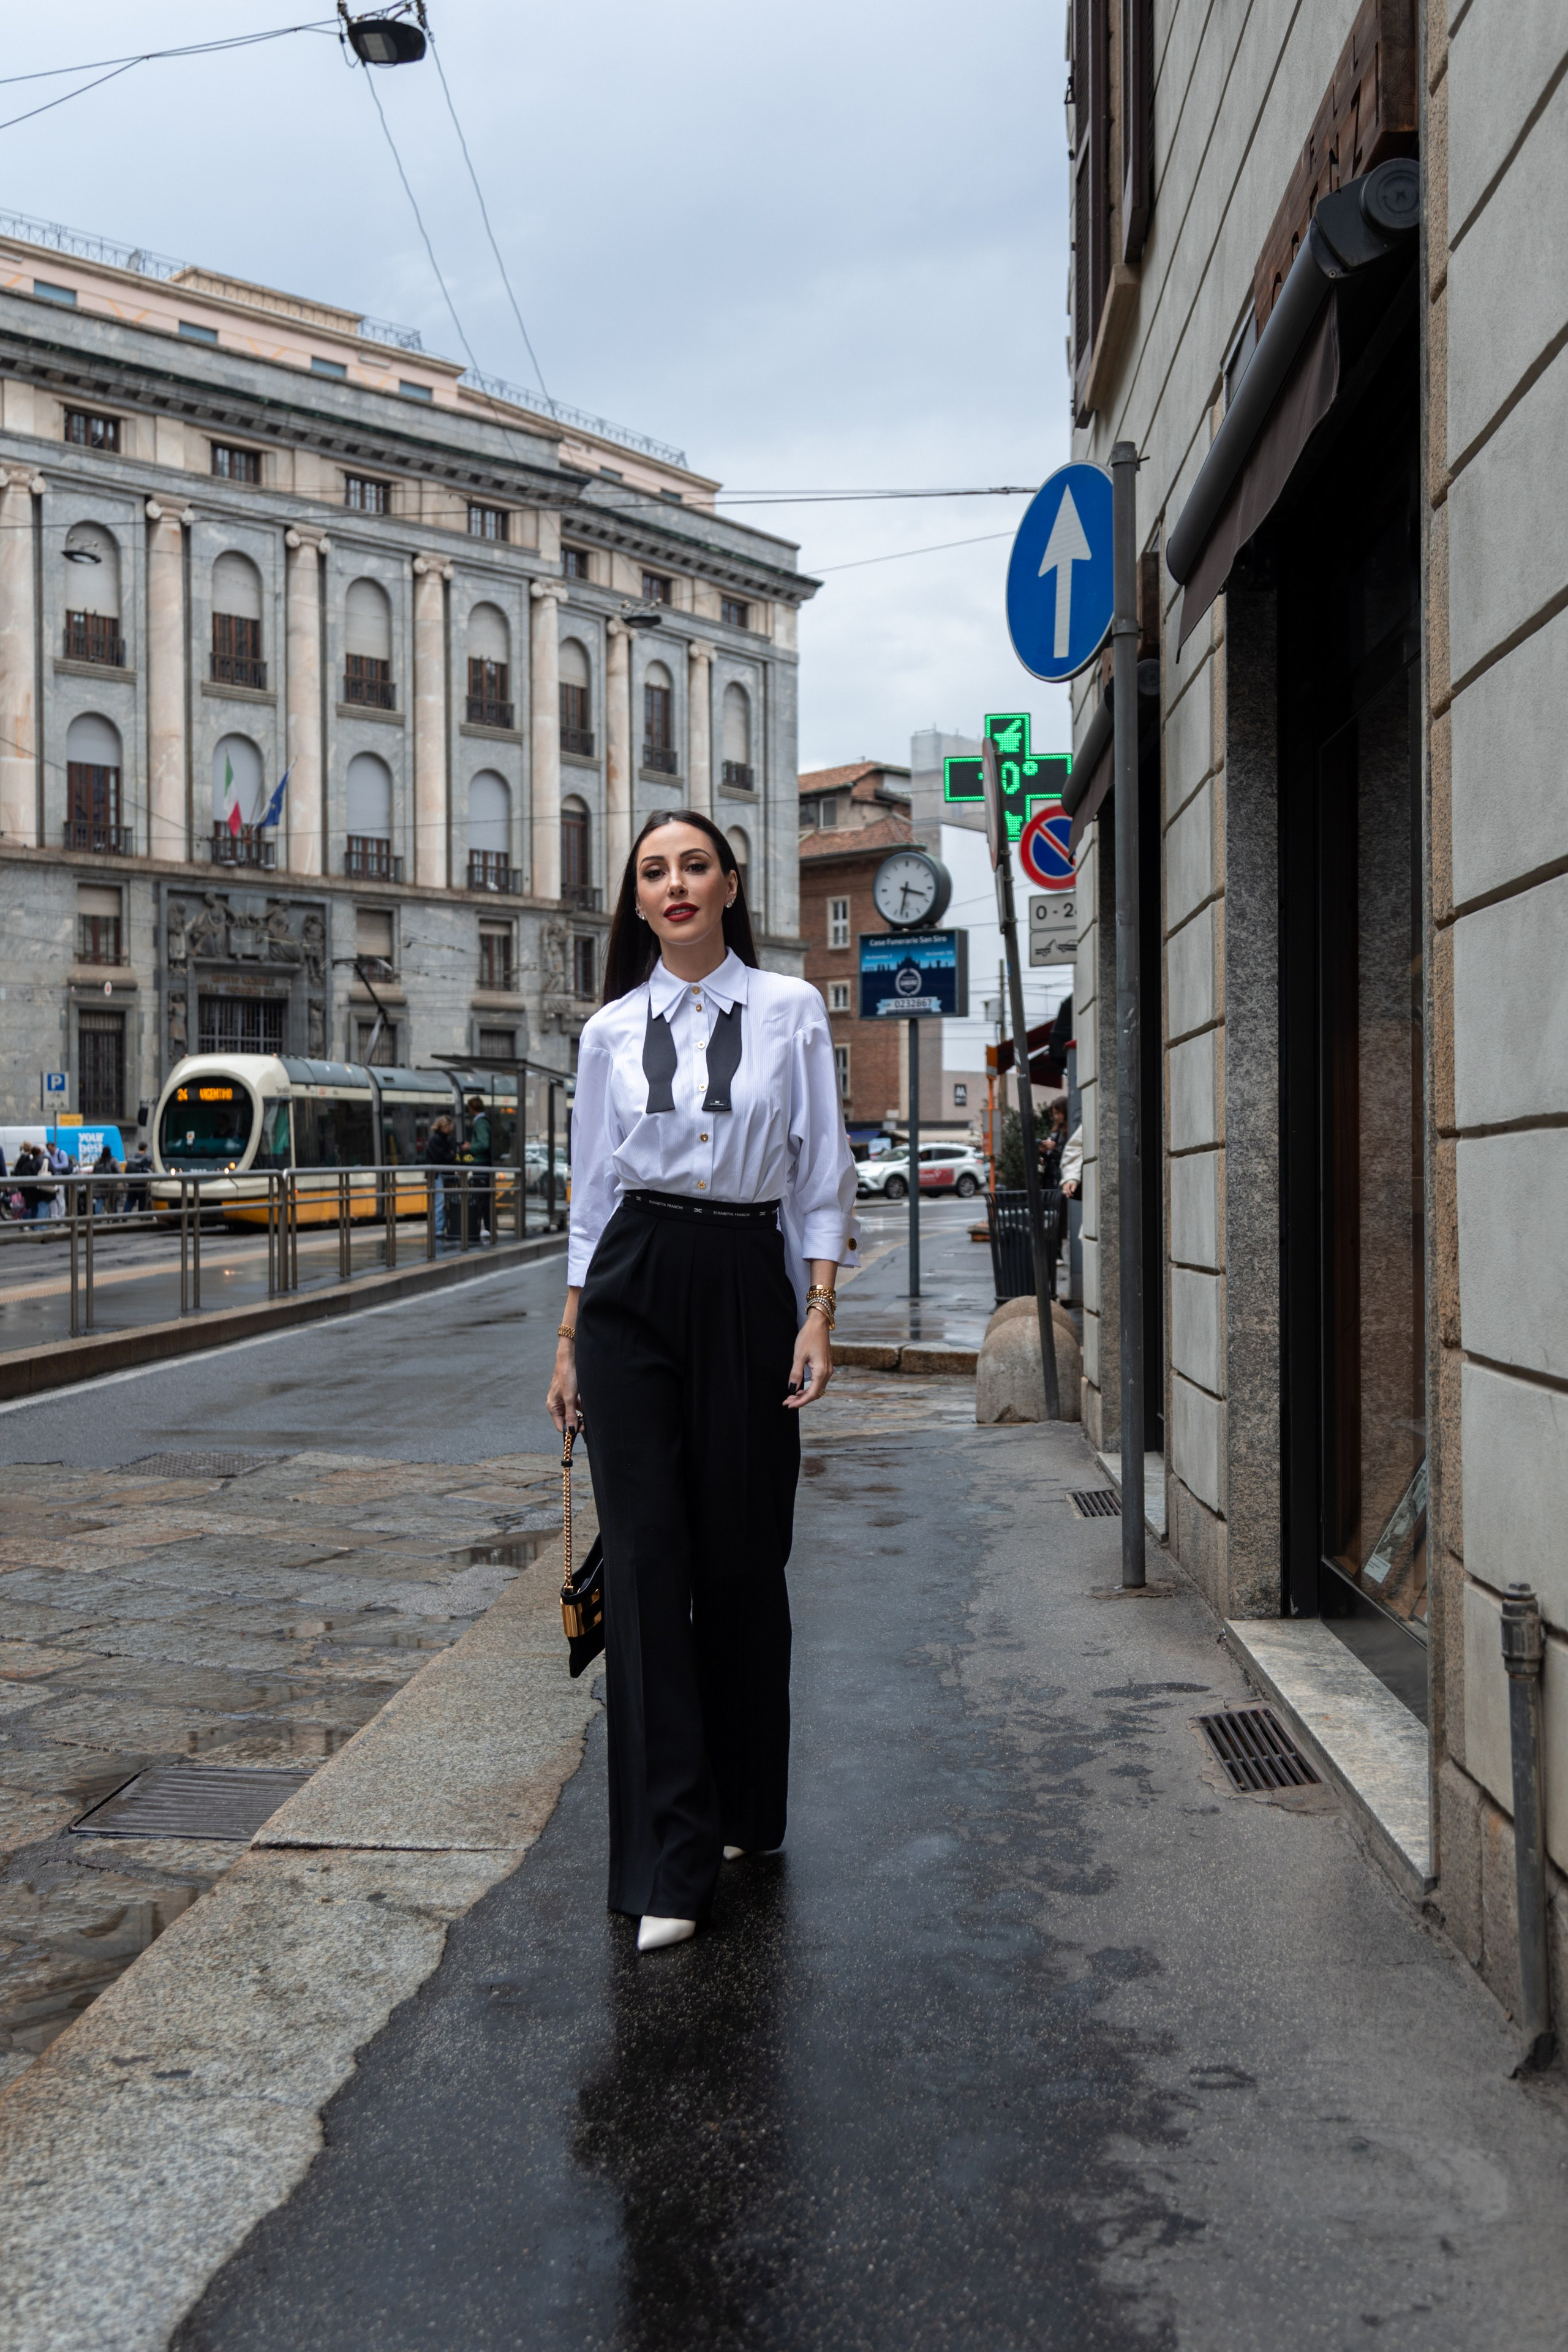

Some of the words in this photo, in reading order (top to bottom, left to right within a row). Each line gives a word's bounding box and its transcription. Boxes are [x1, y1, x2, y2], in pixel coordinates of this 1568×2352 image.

[1036, 905, 1047, 919] 0
[1063, 902, 1077, 918] 2
[887, 936, 919, 946] Funerarie
[919, 935, 932, 944] San
[894, 998, 932, 1008] 0232867
[51, 1075, 62, 1090] P
[78, 1133, 104, 1142] your
